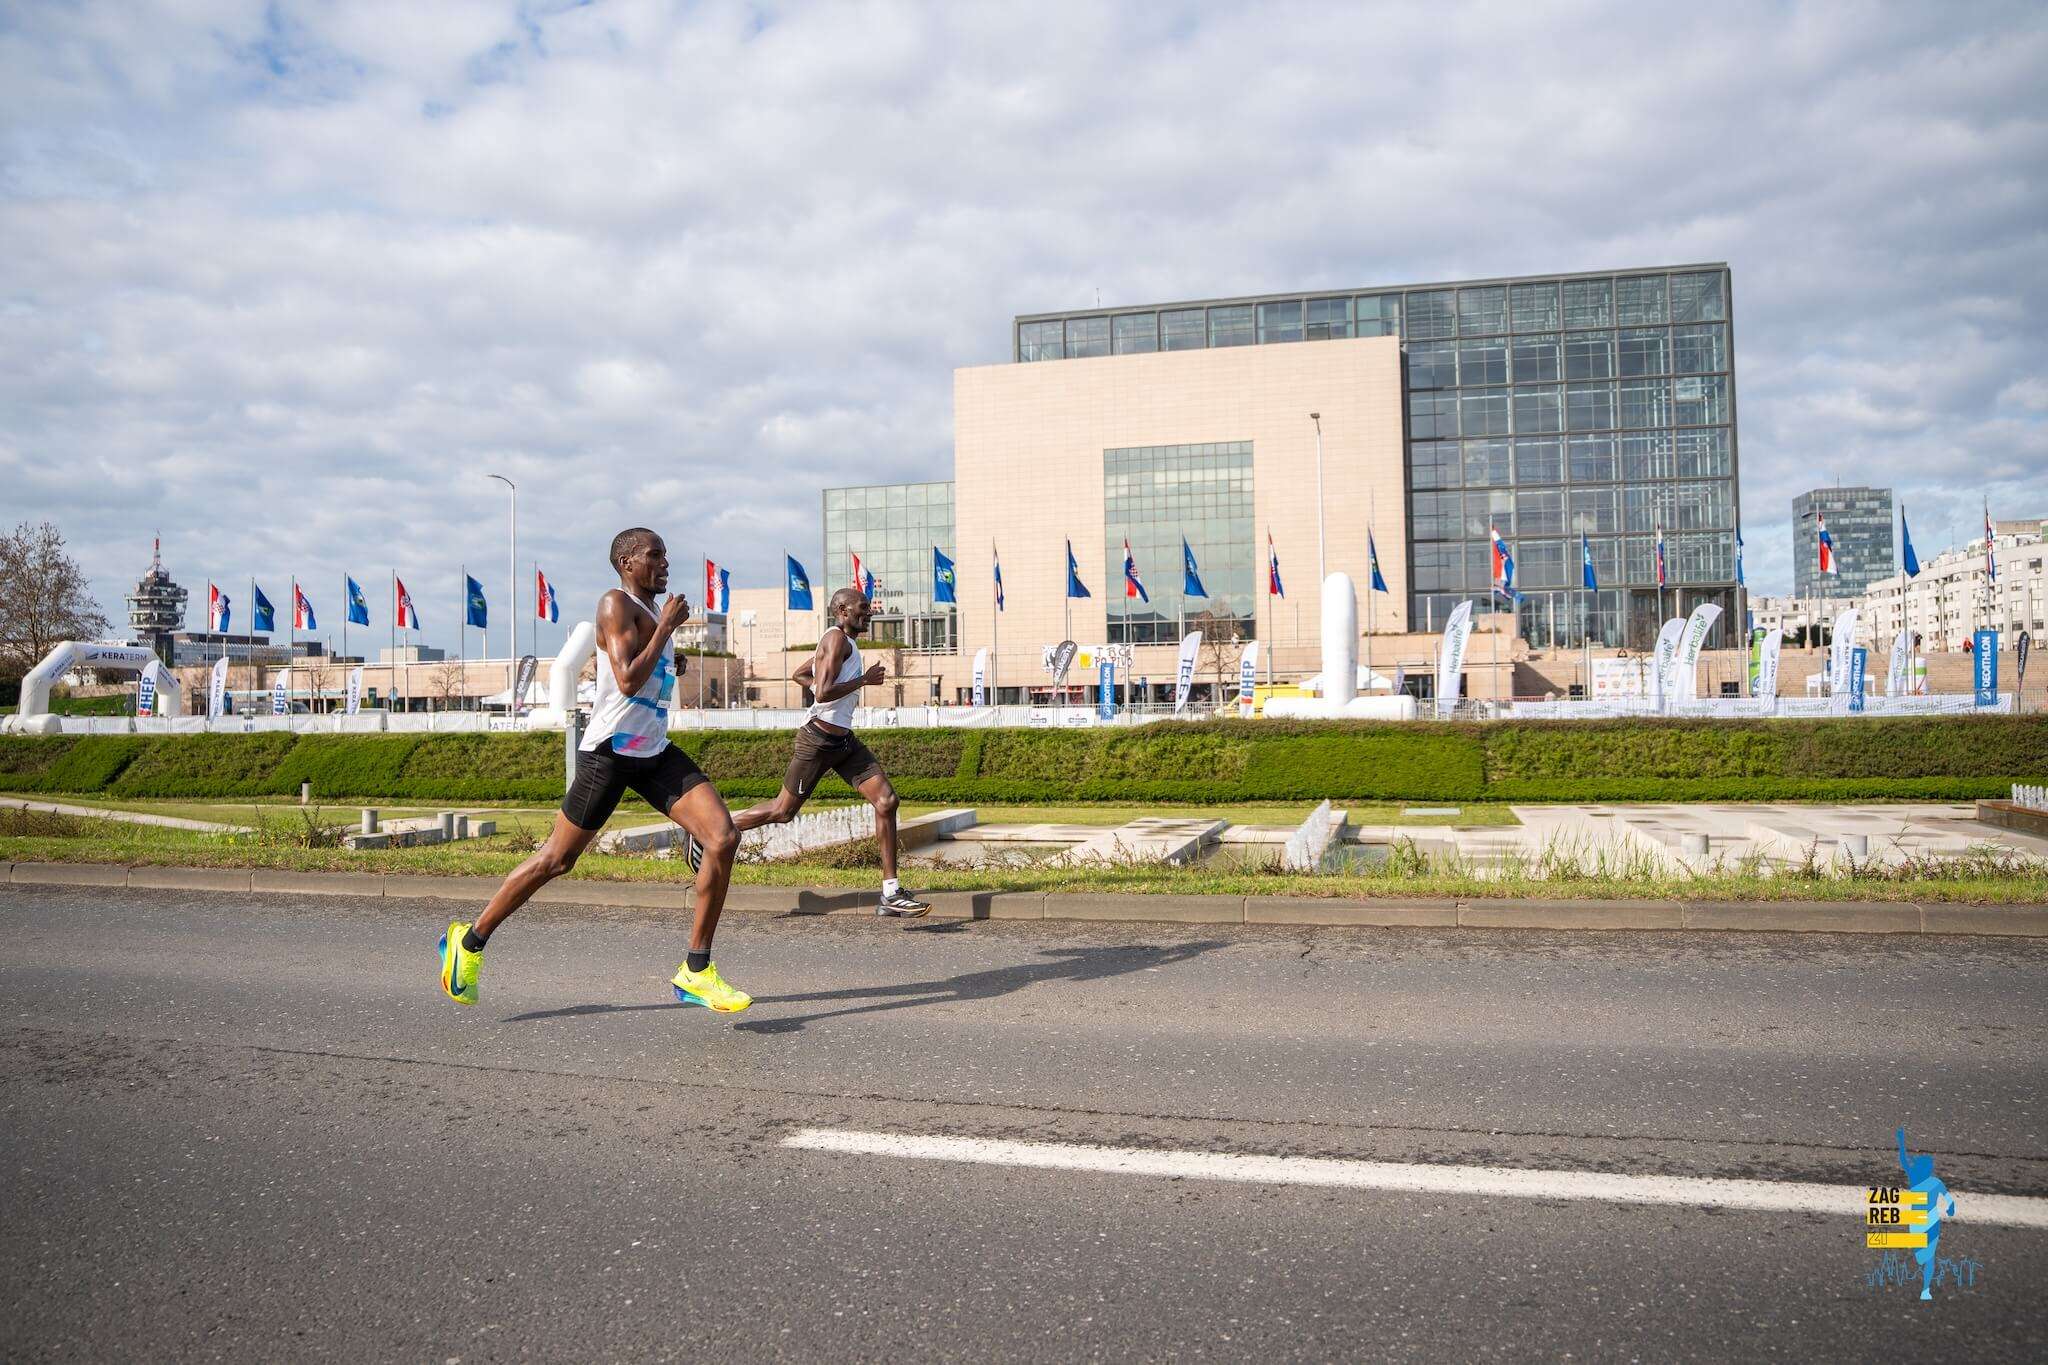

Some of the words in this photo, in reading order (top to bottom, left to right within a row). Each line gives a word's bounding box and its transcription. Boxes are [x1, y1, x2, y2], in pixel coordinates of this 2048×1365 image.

[874, 588, 903, 598] trium
[1684, 619, 1707, 665] Herbalife
[102, 651, 147, 661] KERATERM
[1981, 636, 1991, 688] DECATHLON
[1241, 660, 1255, 689] HEP
[141, 677, 155, 702] HEP
[274, 683, 286, 707] HEP
